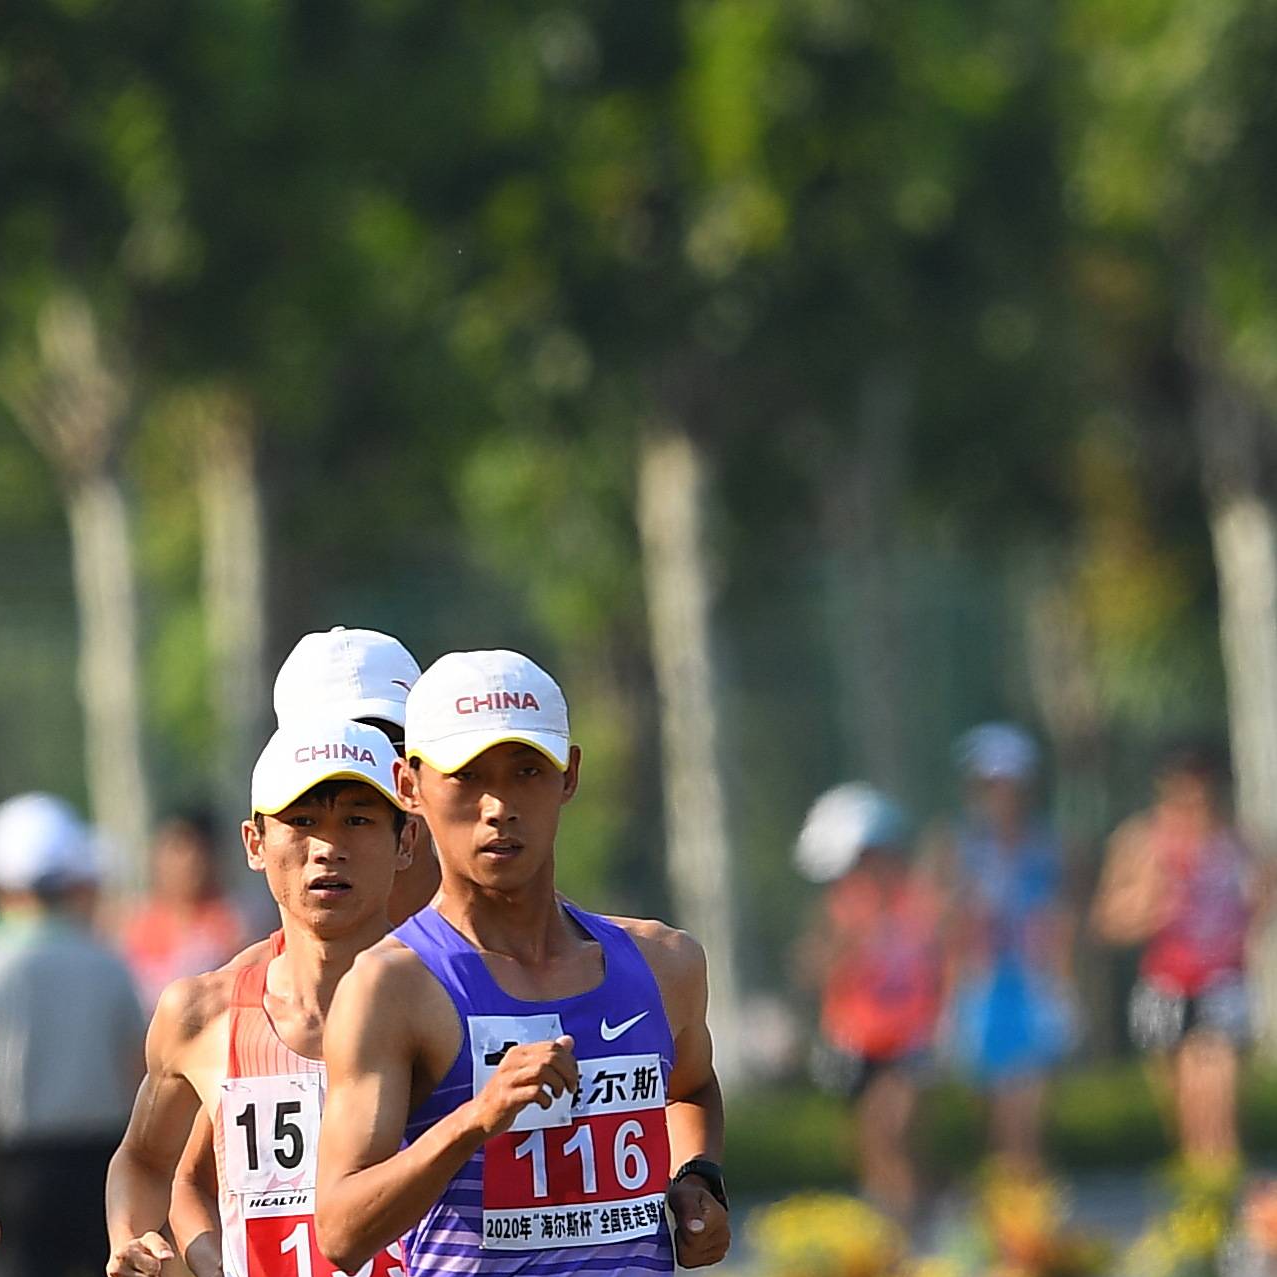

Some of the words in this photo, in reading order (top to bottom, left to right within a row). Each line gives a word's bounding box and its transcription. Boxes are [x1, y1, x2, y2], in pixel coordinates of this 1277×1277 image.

[456, 691, 540, 715] CHINA
[294, 743, 377, 767] CHINA
[236, 1101, 304, 1170] 15
[515, 1119, 649, 1198] 116
[249, 1195, 307, 1208] HEALTH
